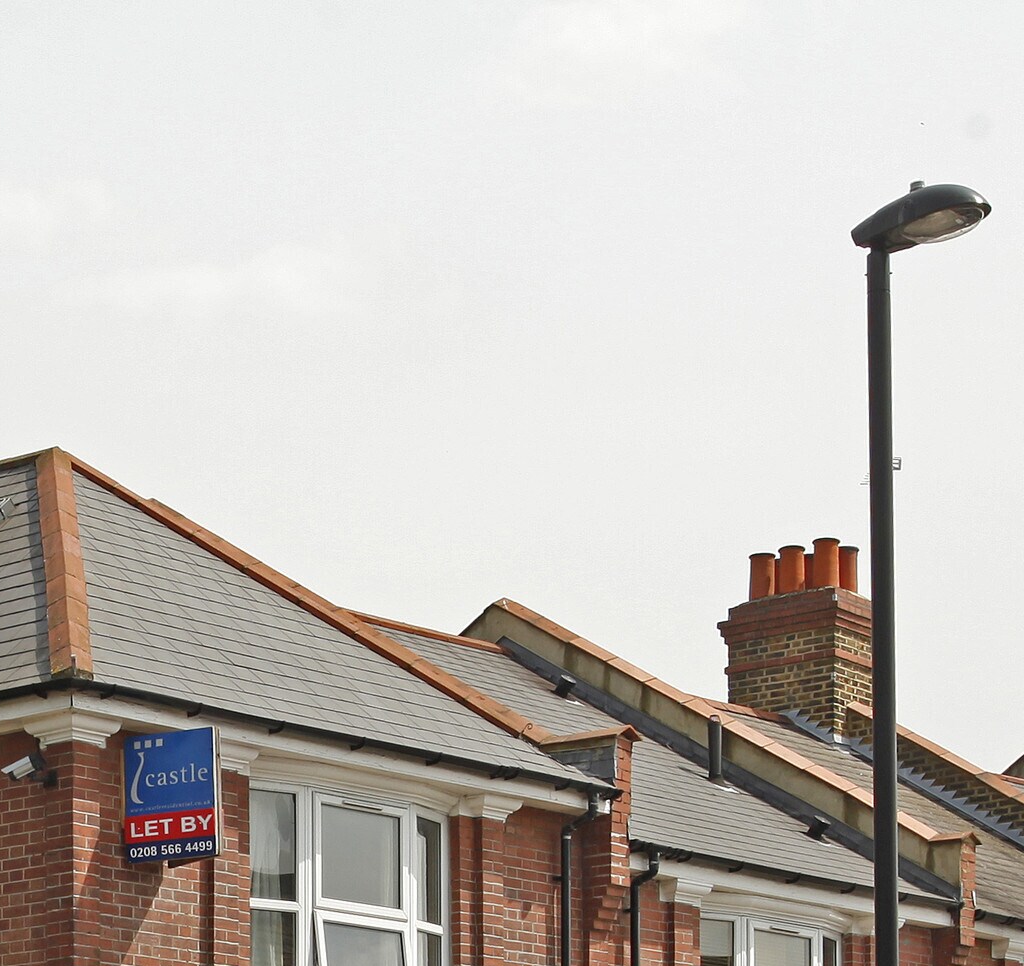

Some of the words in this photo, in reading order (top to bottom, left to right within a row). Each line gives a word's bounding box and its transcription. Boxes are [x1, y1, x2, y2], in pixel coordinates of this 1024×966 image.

[145, 763, 208, 787] castle
[130, 818, 174, 838] LET
[181, 814, 213, 833] BY
[130, 846, 157, 858] 0208
[161, 844, 182, 855] 566
[185, 840, 213, 853] 4499
